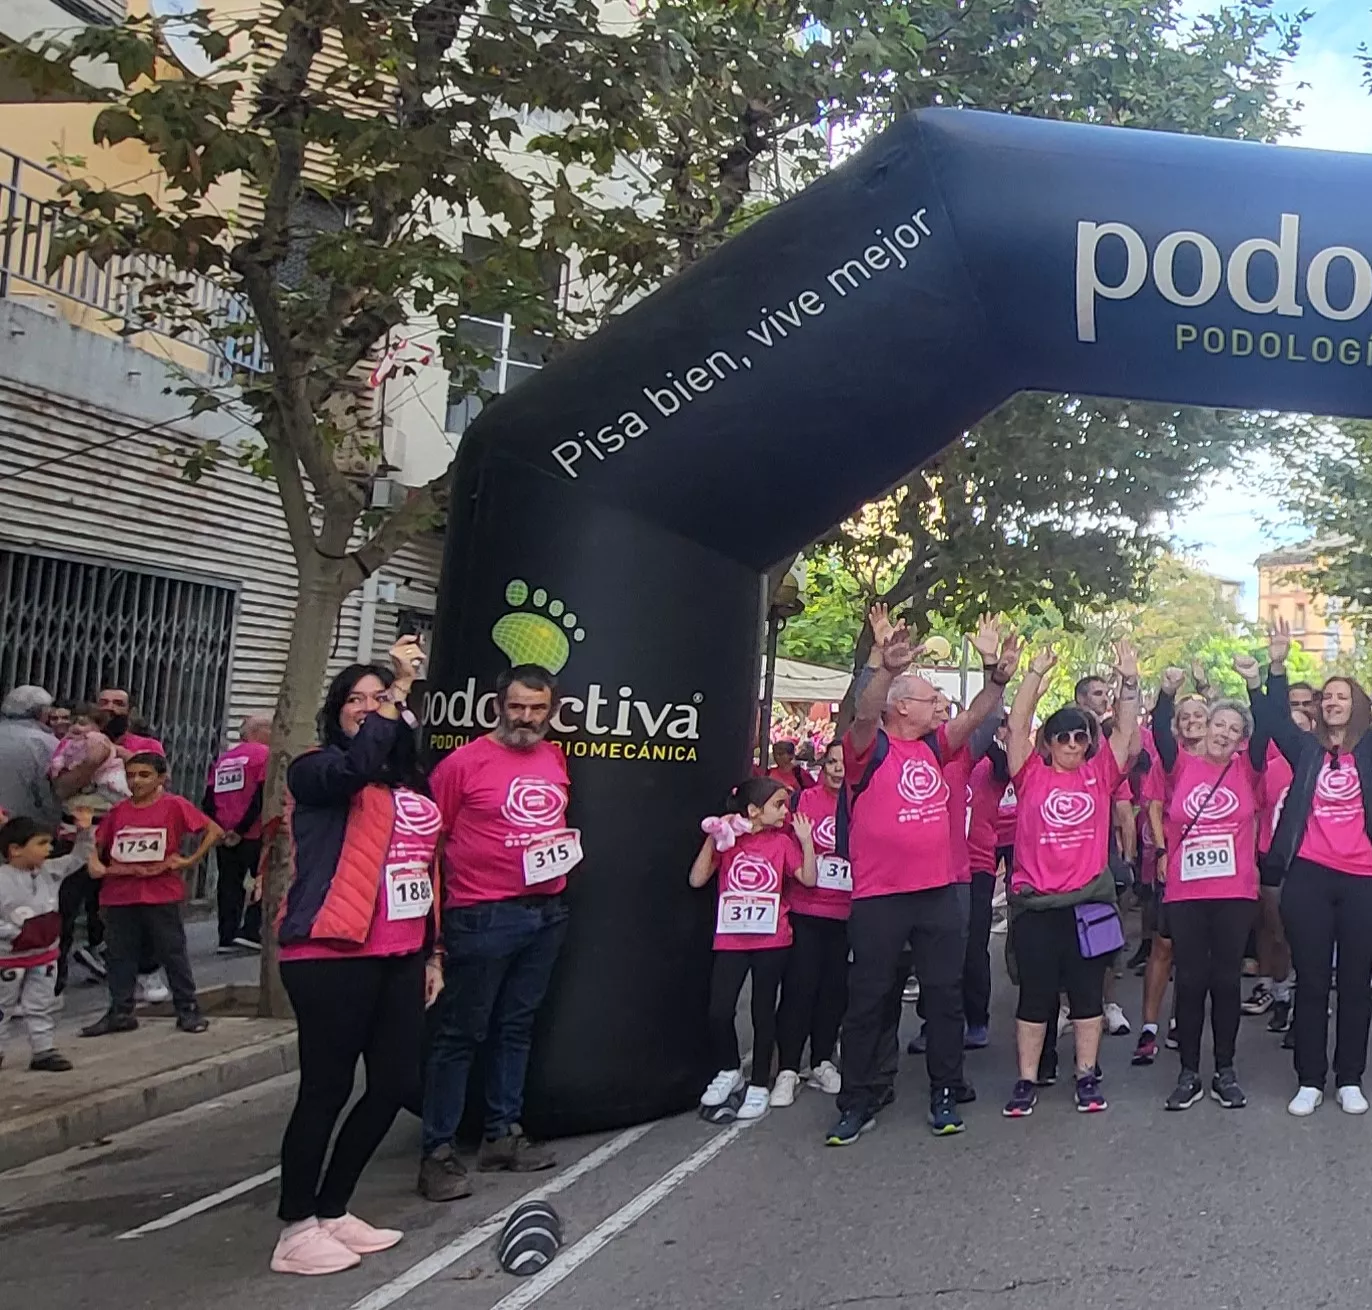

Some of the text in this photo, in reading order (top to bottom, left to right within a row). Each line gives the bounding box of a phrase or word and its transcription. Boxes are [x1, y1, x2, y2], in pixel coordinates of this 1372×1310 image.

[551, 208, 931, 478] Pisa bien, vive mejor
[117, 840, 159, 855] 1754
[534, 844, 569, 869] 315
[1187, 849, 1228, 868] 1890
[730, 906, 767, 921] 317
